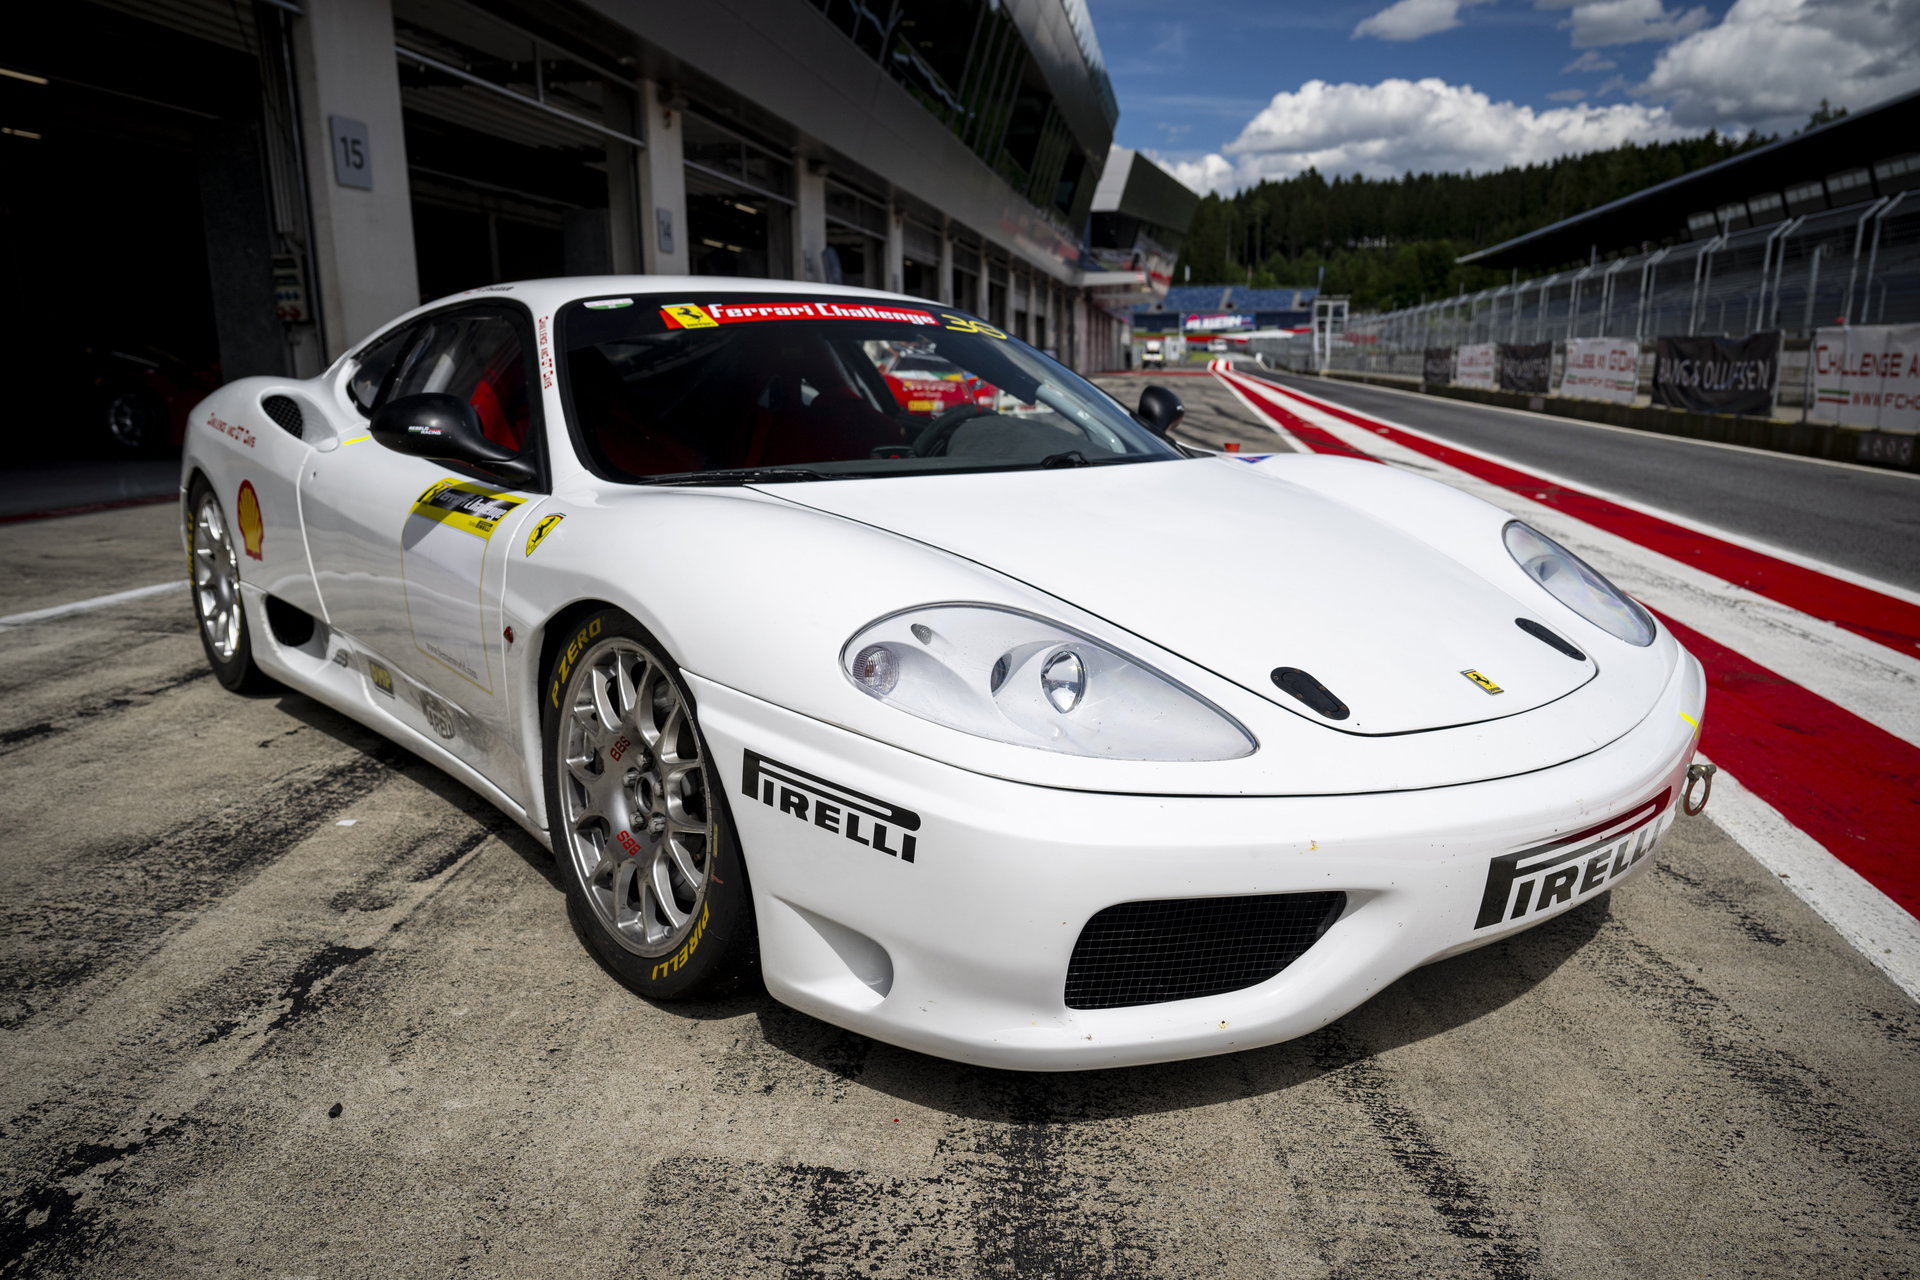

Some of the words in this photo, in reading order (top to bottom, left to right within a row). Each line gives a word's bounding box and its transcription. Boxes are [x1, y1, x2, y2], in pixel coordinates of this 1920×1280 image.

[340, 136, 364, 169] 15
[707, 303, 811, 318] Ferrari
[814, 302, 937, 325] Challenge
[550, 684, 562, 708] P
[558, 617, 601, 683] ZERO
[609, 734, 631, 762] BBS
[741, 747, 921, 865] PIRELLI
[616, 829, 641, 857] BBS
[1473, 785, 1673, 931] PIRELLI
[652, 900, 710, 981] PIRELLI
